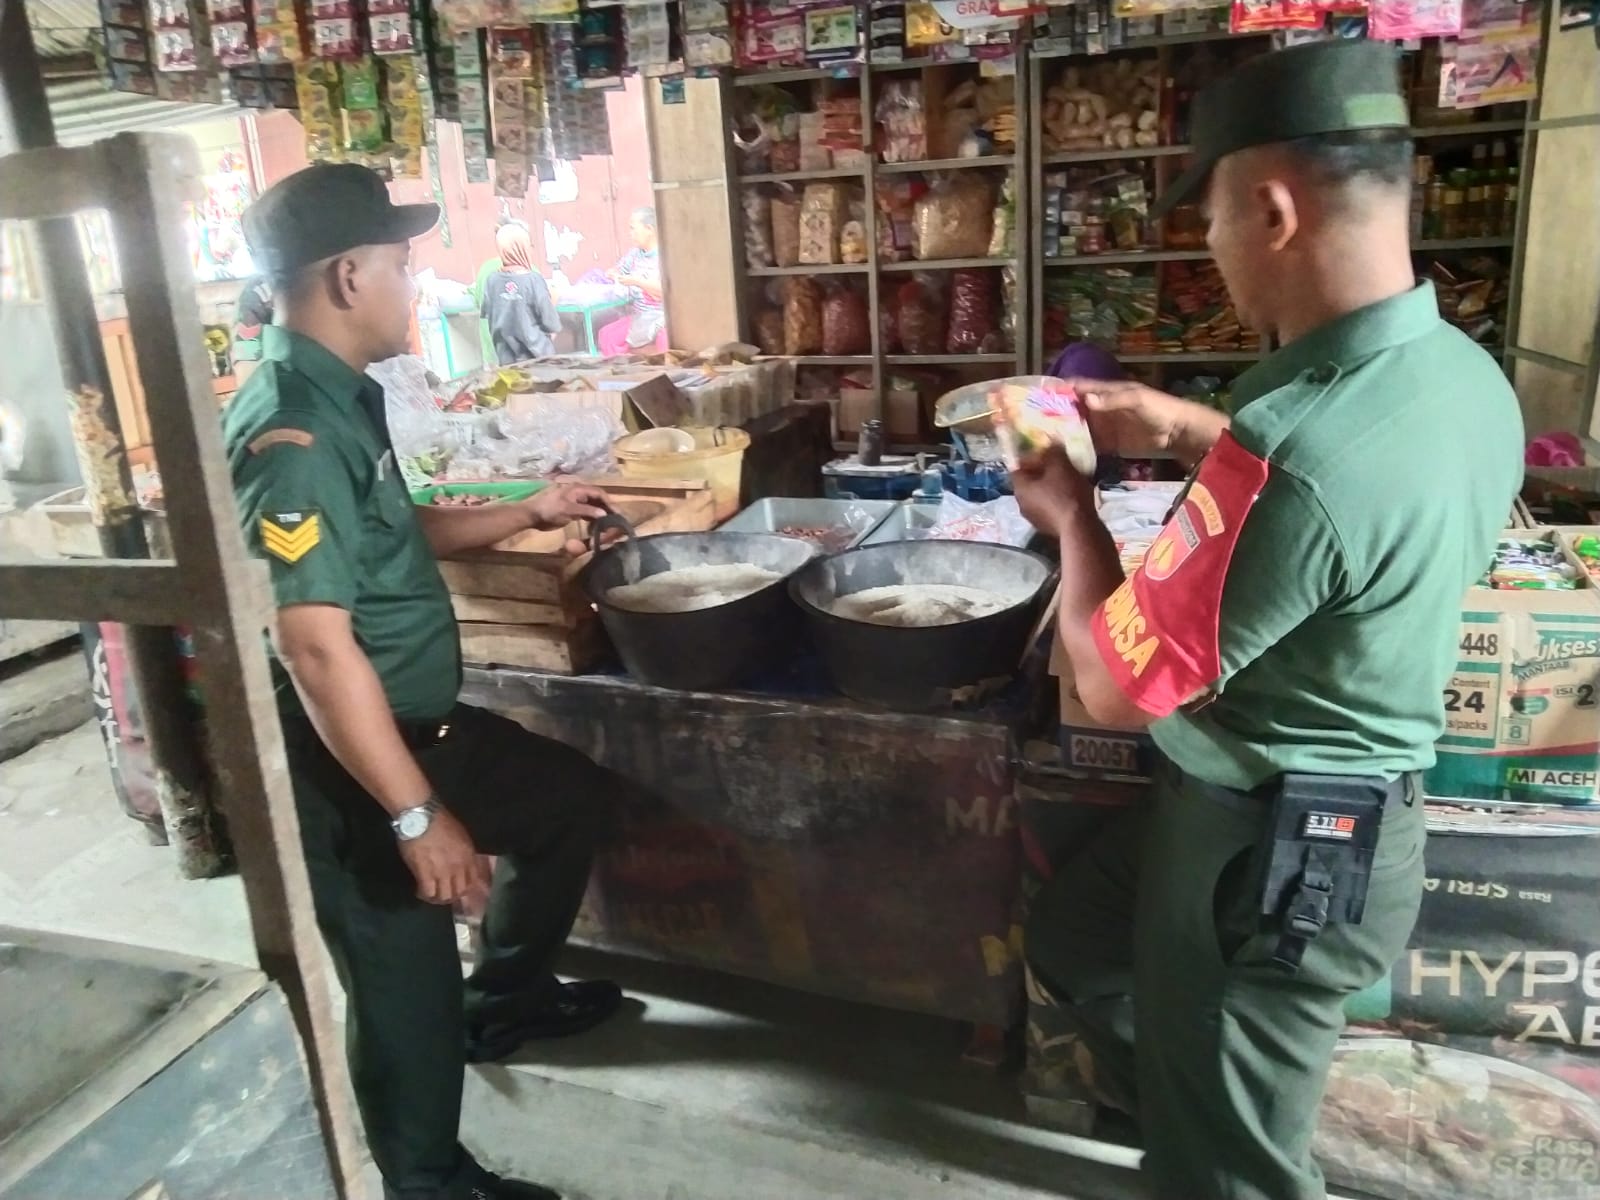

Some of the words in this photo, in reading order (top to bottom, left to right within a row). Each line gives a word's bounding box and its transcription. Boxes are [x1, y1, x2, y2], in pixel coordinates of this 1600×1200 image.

[1460, 632, 1498, 656] 448
[1534, 638, 1599, 662] ukses
[1452, 678, 1490, 688] Content
[1443, 689, 1485, 714] 24
[1577, 684, 1595, 706] 2
[1446, 720, 1488, 733] s/packs
[1512, 769, 1536, 783] MI
[1542, 771, 1597, 786] ACEH
[1535, 1135, 1594, 1157] Rasa
